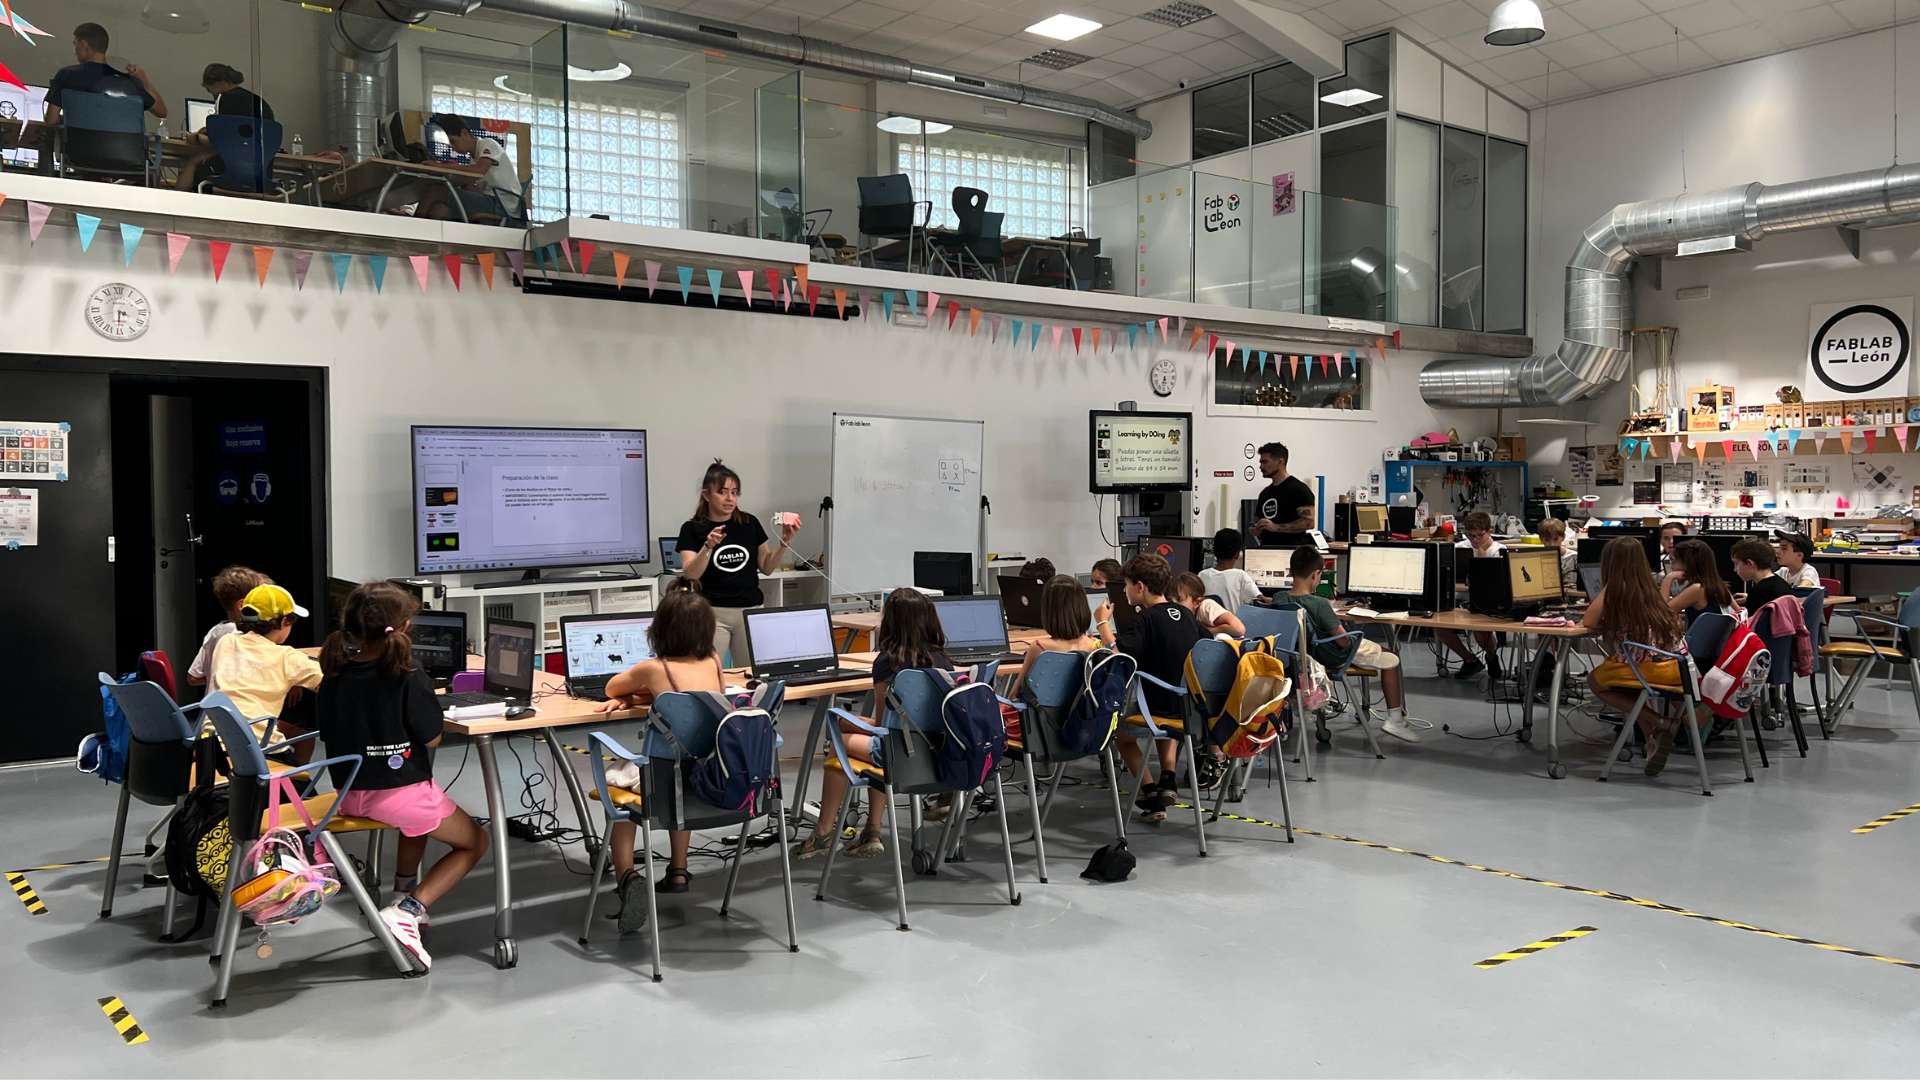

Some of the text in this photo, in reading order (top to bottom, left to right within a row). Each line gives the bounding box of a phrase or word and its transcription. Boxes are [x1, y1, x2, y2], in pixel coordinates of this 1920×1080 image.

[1826, 336, 1893, 351] FABLAB
[1851, 350, 1890, 363] León
[1117, 430, 1166, 440] Learning by DOing
[1732, 440, 1788, 452] ELECRÓCA
